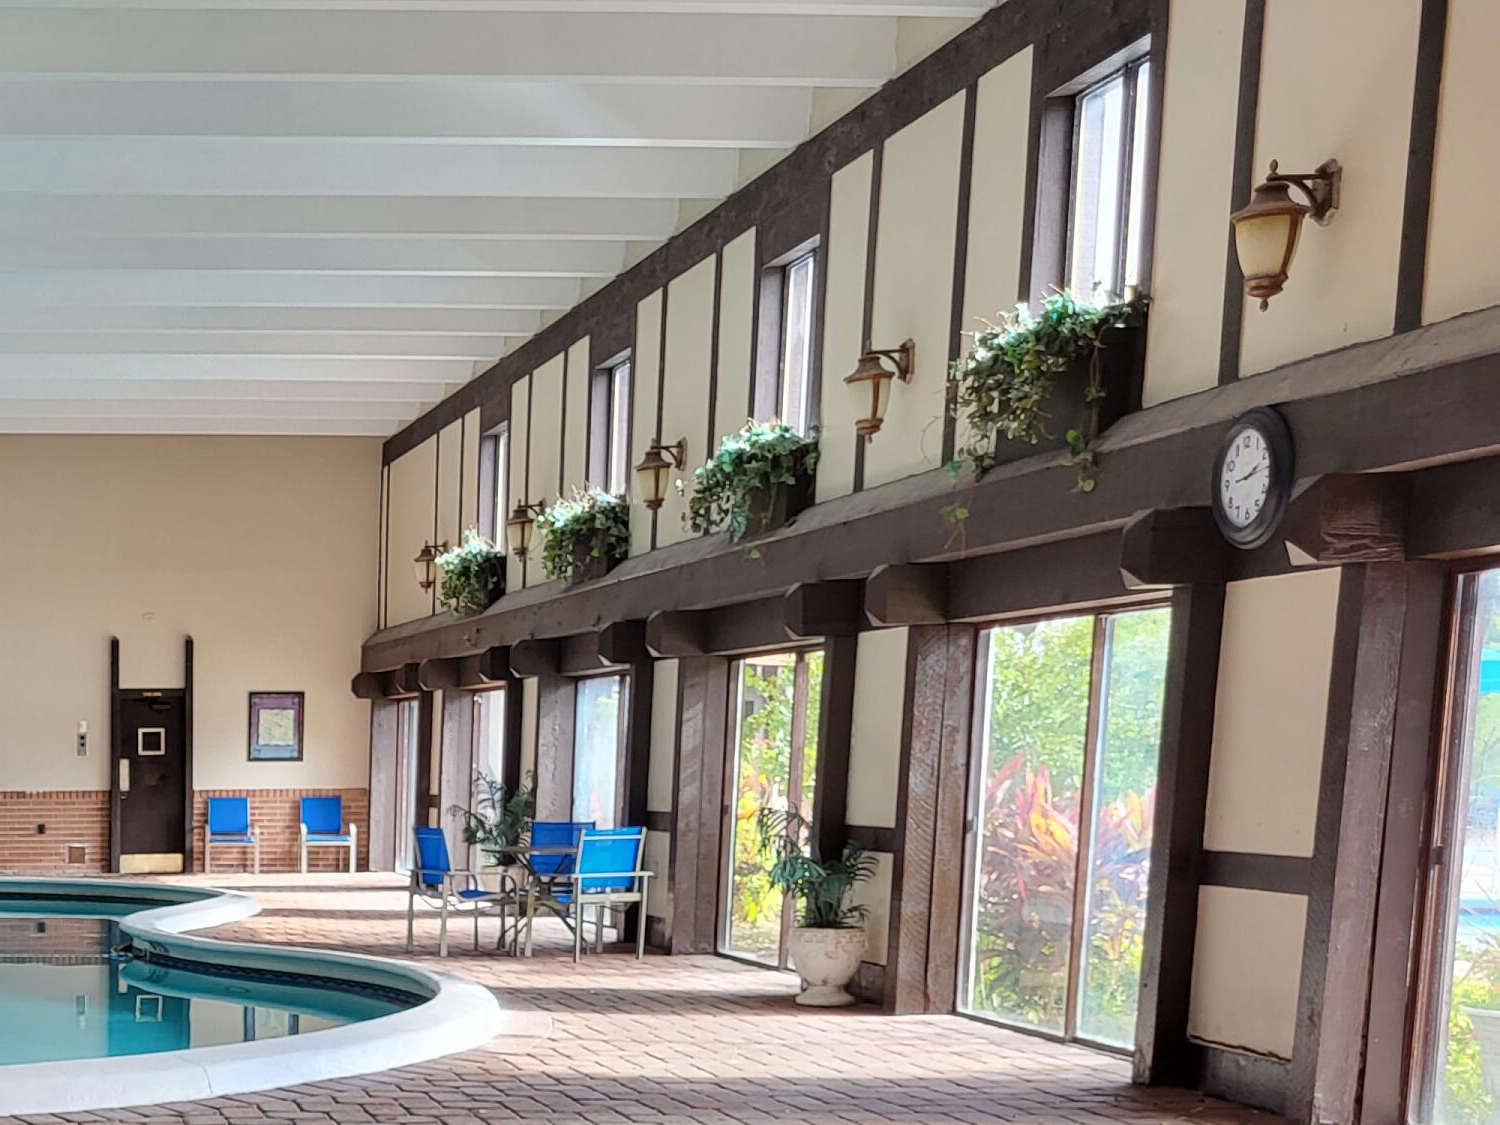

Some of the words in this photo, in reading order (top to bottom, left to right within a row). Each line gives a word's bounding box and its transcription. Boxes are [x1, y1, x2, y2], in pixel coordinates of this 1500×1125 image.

[1243, 435, 1251, 448] 12
[1226, 460, 1235, 473] 10
[1225, 479, 1230, 492] 9
[1228, 496, 1233, 509] 8
[1235, 505, 1240, 519] 7
[1245, 507, 1250, 520] 6
